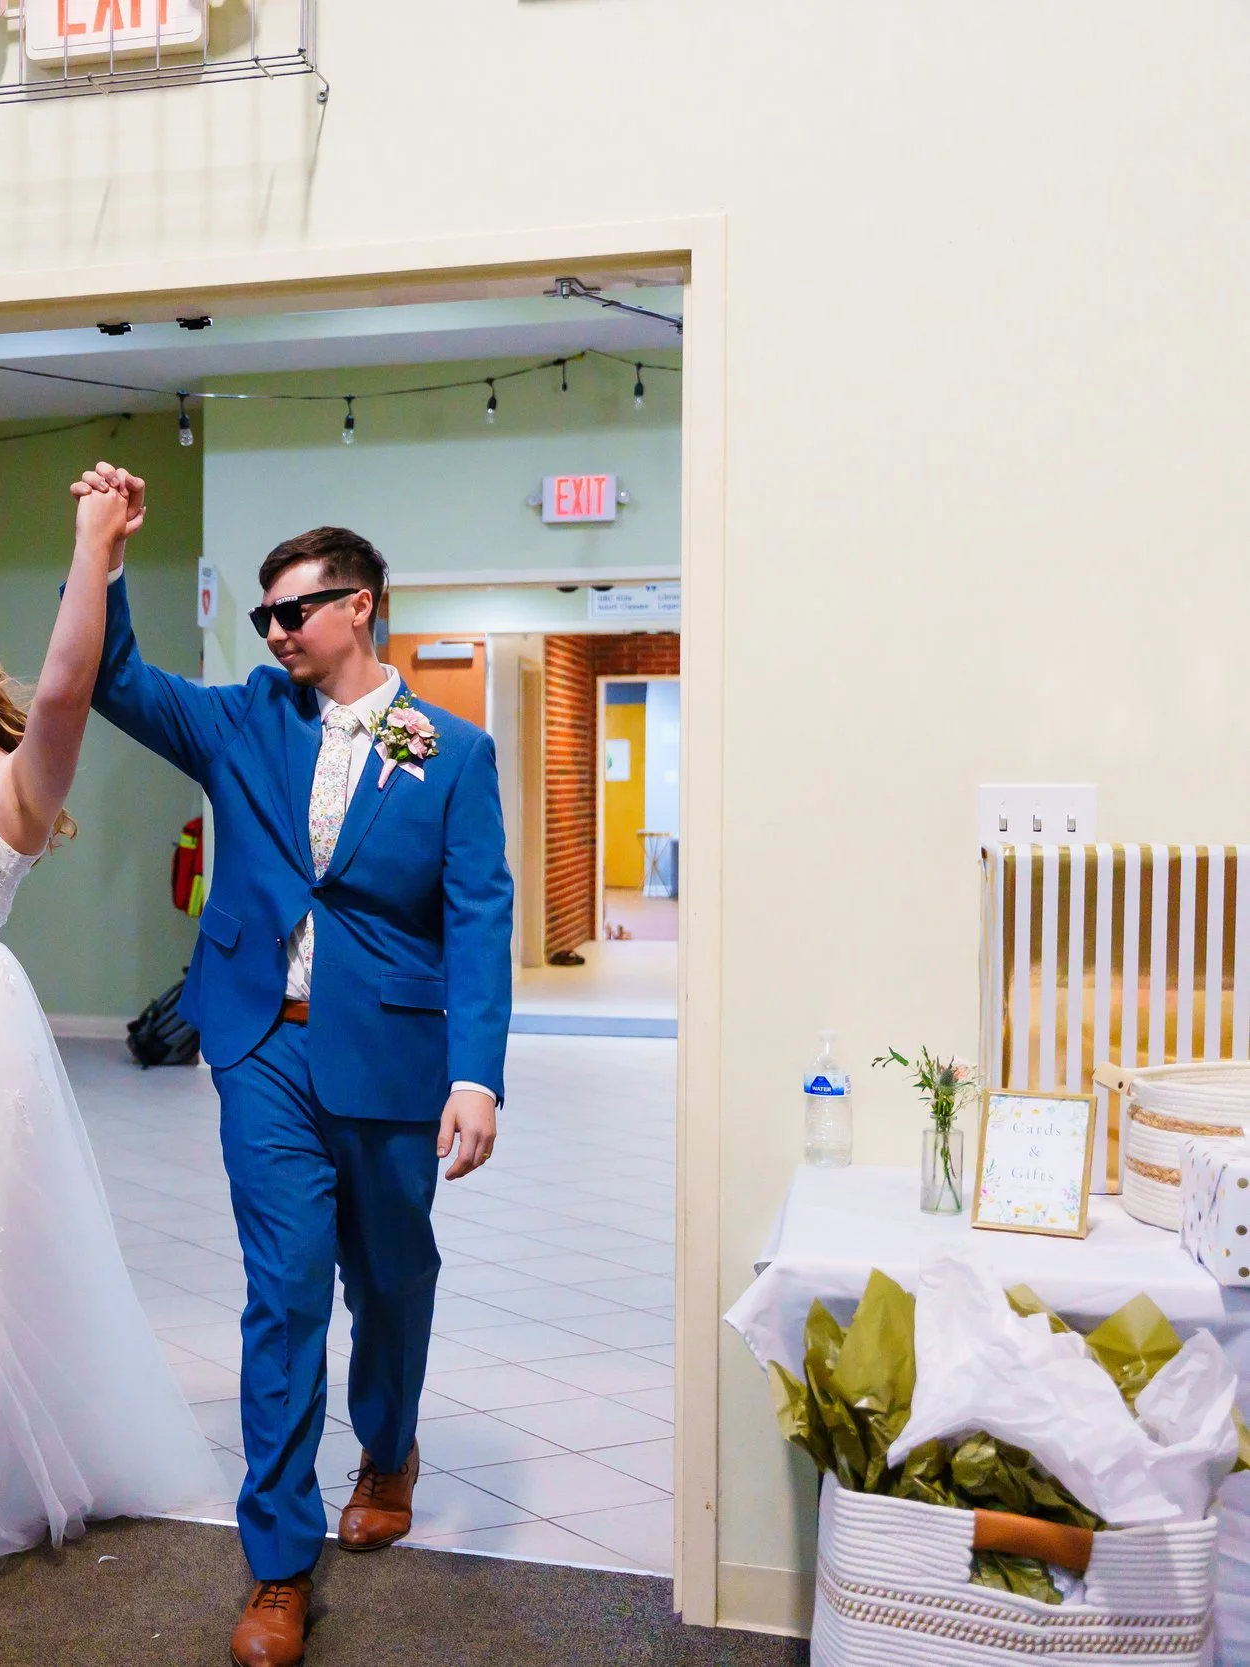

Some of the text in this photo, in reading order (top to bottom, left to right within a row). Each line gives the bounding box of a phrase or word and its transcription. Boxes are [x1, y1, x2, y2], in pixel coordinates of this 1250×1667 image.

[555, 475, 607, 517] EXIT
[1012, 1121, 1063, 1137] Cards
[1028, 1145, 1042, 1159] &
[1011, 1166, 1055, 1182] Gifts
